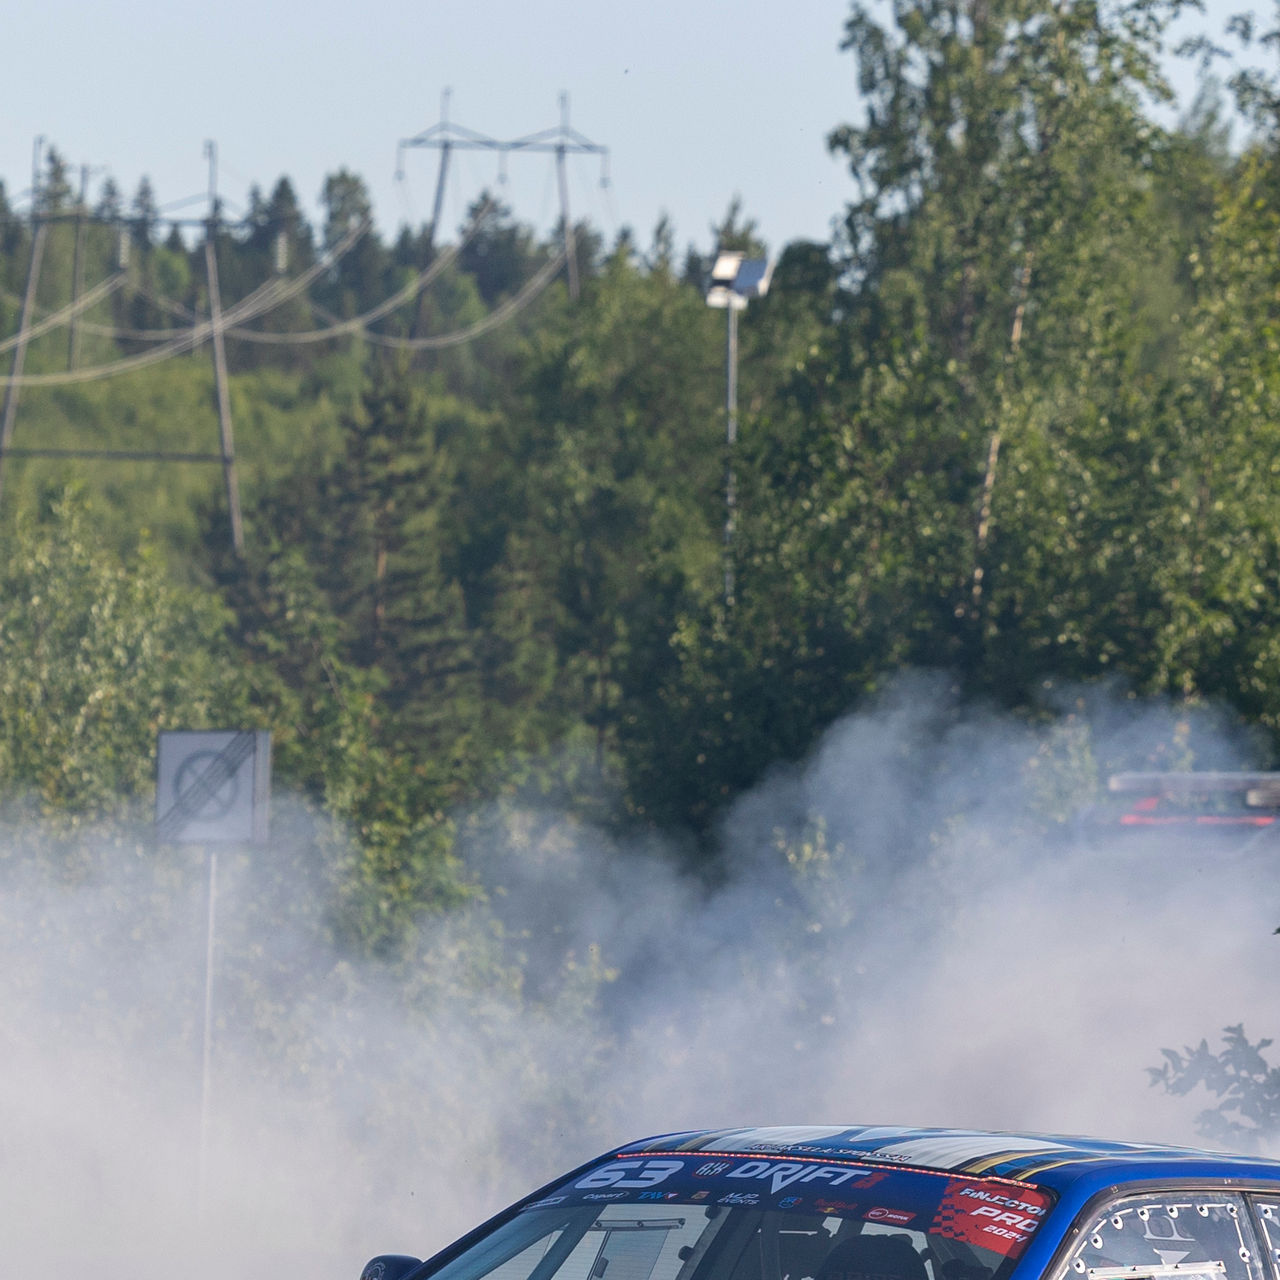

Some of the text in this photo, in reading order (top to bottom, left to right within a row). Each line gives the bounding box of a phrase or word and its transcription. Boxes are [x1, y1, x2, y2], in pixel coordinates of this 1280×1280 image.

[575, 1161, 684, 1188] 63
[726, 1161, 871, 1194] DRIFT
[970, 1206, 1039, 1232] PRO
[983, 1225, 1028, 1242] 2024
